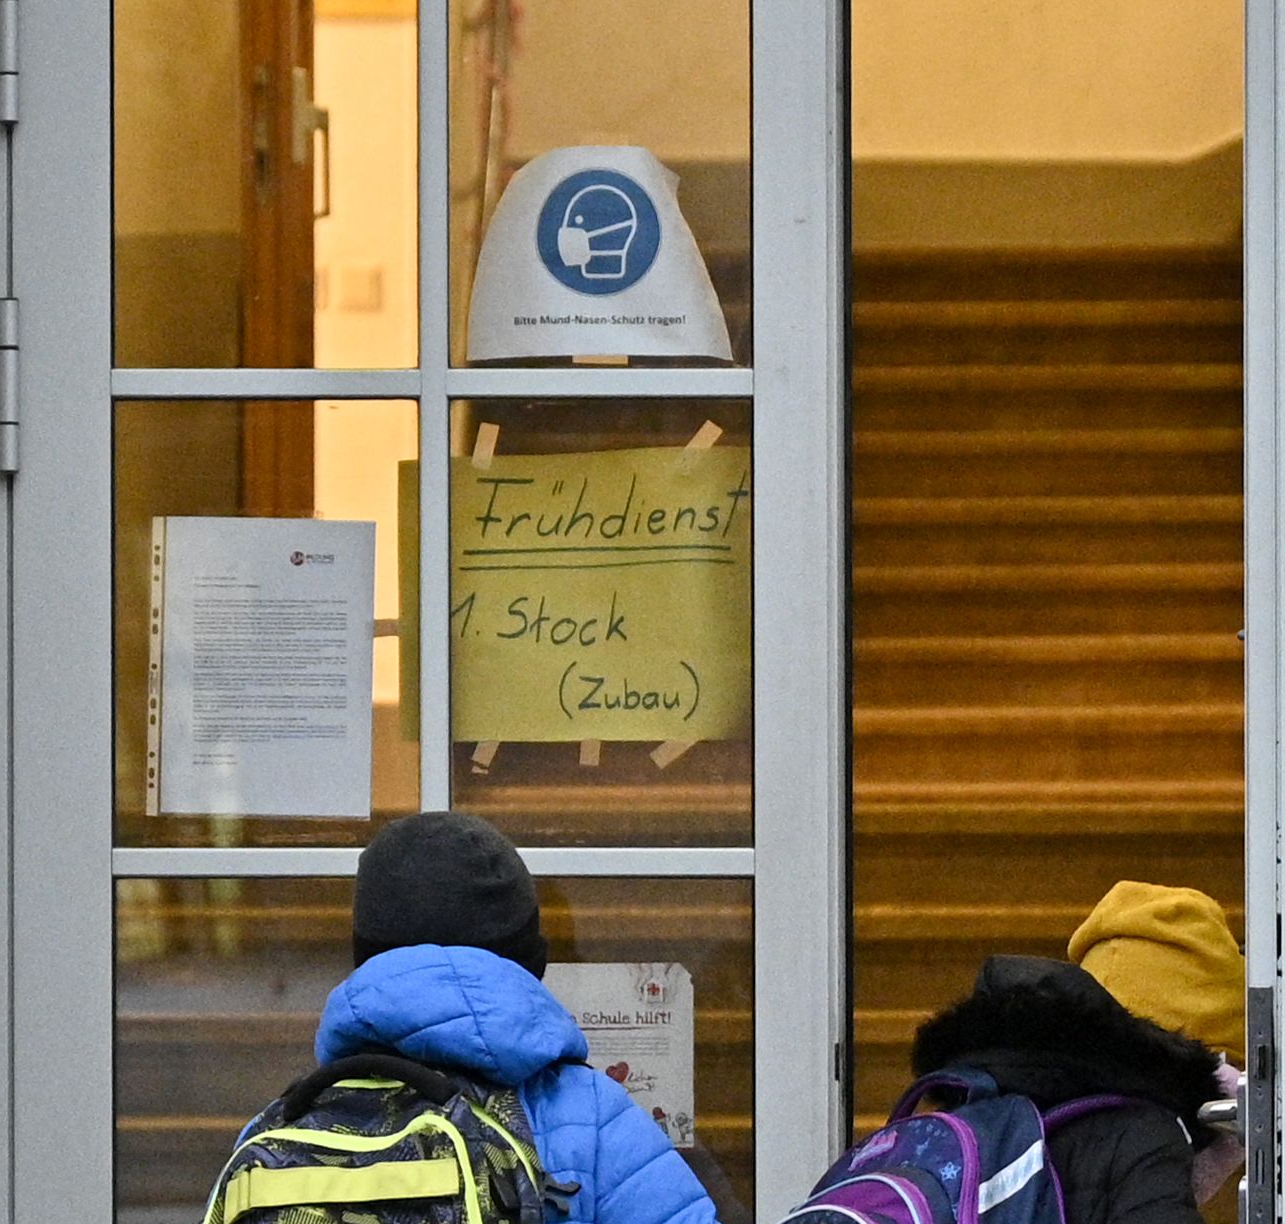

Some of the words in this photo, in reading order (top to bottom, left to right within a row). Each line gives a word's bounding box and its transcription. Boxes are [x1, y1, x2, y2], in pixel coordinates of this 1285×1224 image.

[514, 316, 537, 326] Bitte
[540, 315, 645, 325] Mund-Nasen-Schutz
[648, 315, 686, 327] tragen!
[475, 470, 749, 538] Frühdienst
[451, 591, 480, 638] 1.
[497, 591, 627, 646] Stock
[559, 660, 700, 721] (Zubau)
[582, 1010, 631, 1025] Schule
[635, 1010, 671, 1025] hilft!
